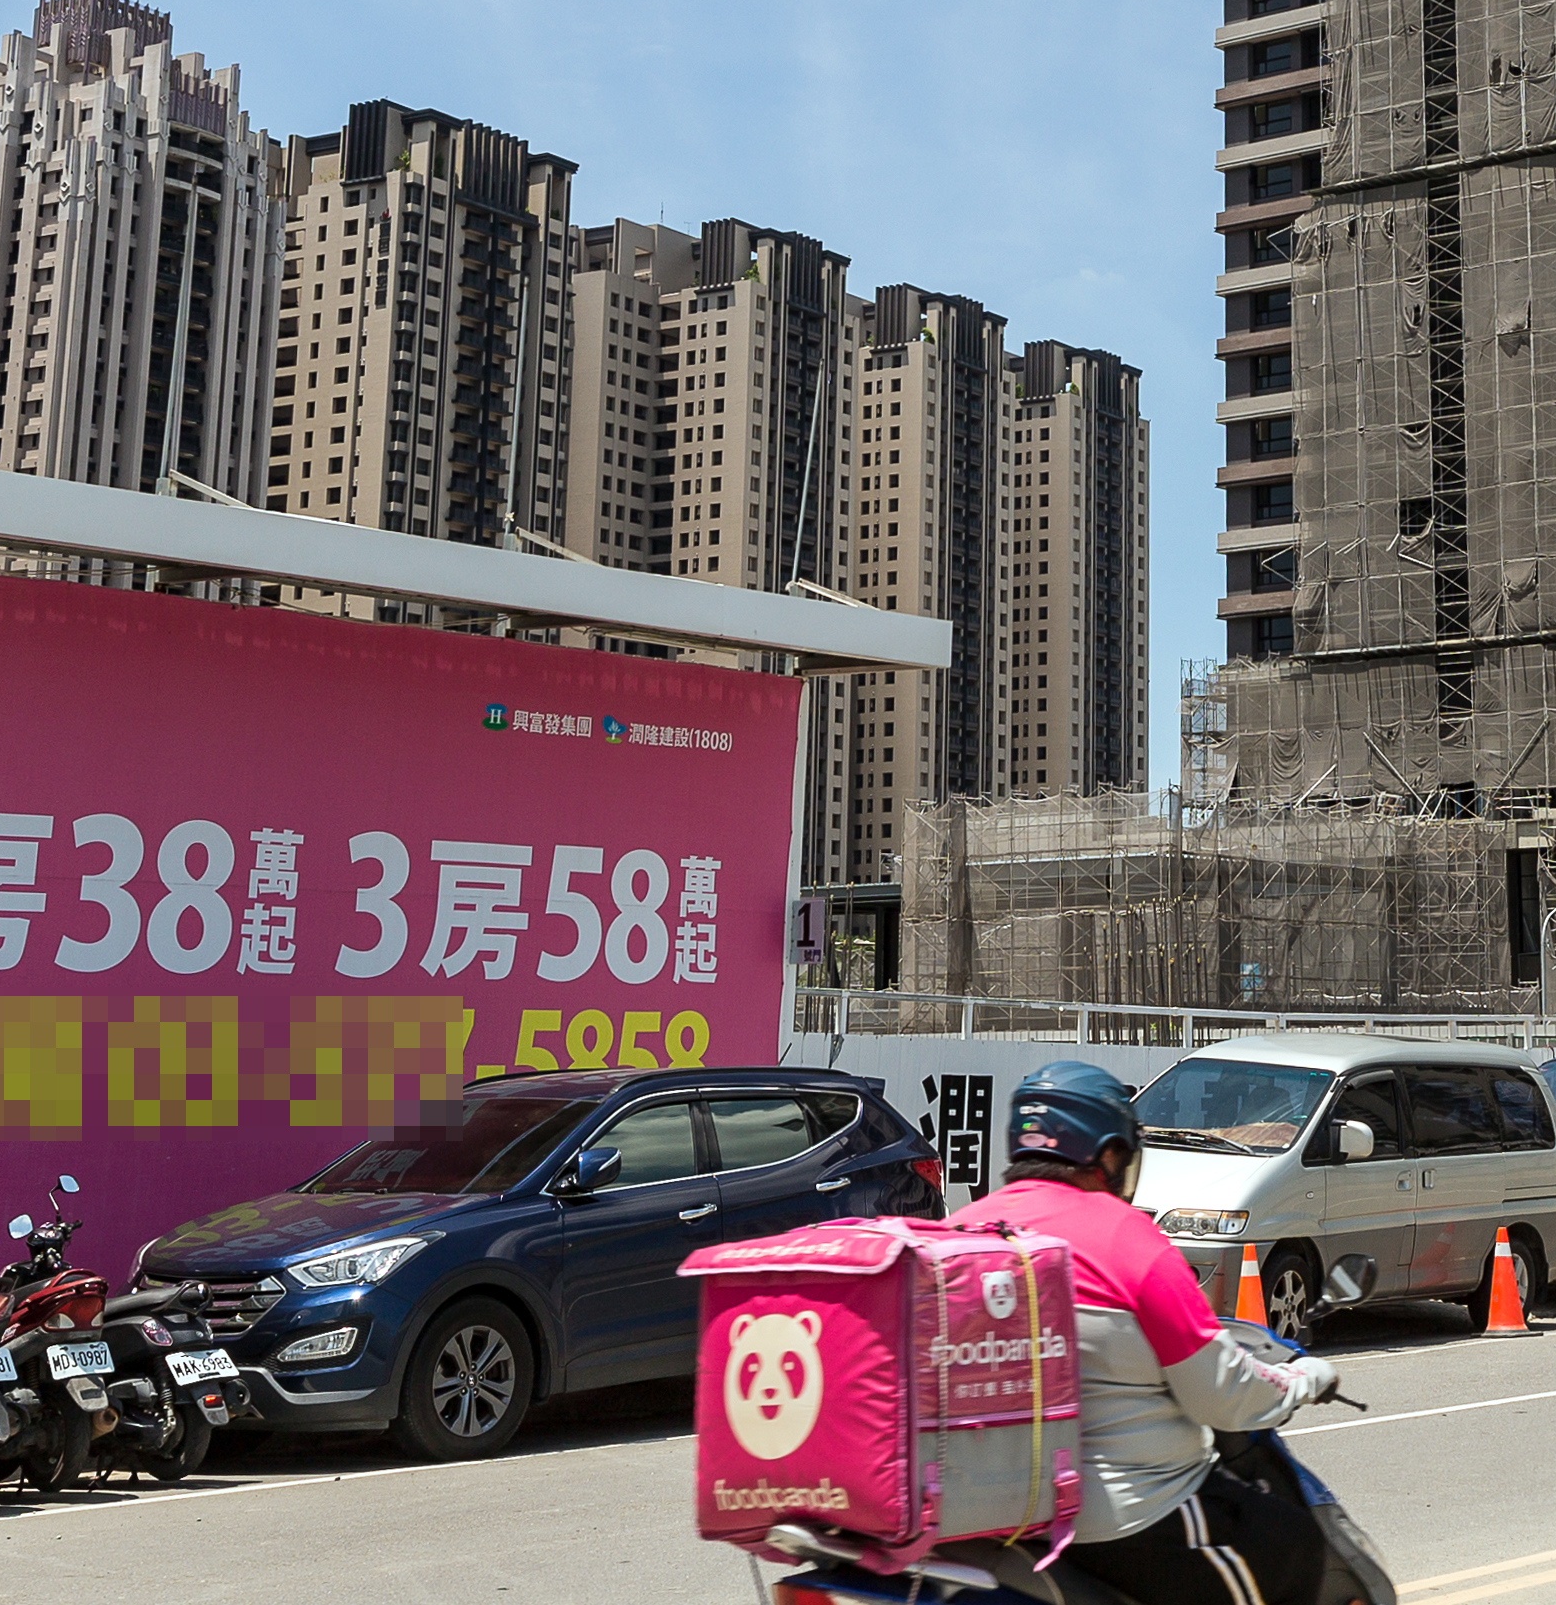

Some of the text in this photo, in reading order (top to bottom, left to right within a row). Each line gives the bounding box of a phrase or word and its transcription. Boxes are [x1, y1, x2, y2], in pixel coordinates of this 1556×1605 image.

[512, 709, 593, 737] 興富發集團
[628, 722, 733, 752] 潤隆建設(1808)
[796, 902, 815, 948] 1
[918, 1074, 994, 1203] 潤
[51, 1349, 108, 1373] MDJ-0987
[929, 1326, 1067, 1372] foodpanda
[713, 1477, 850, 1514] foodpanda
